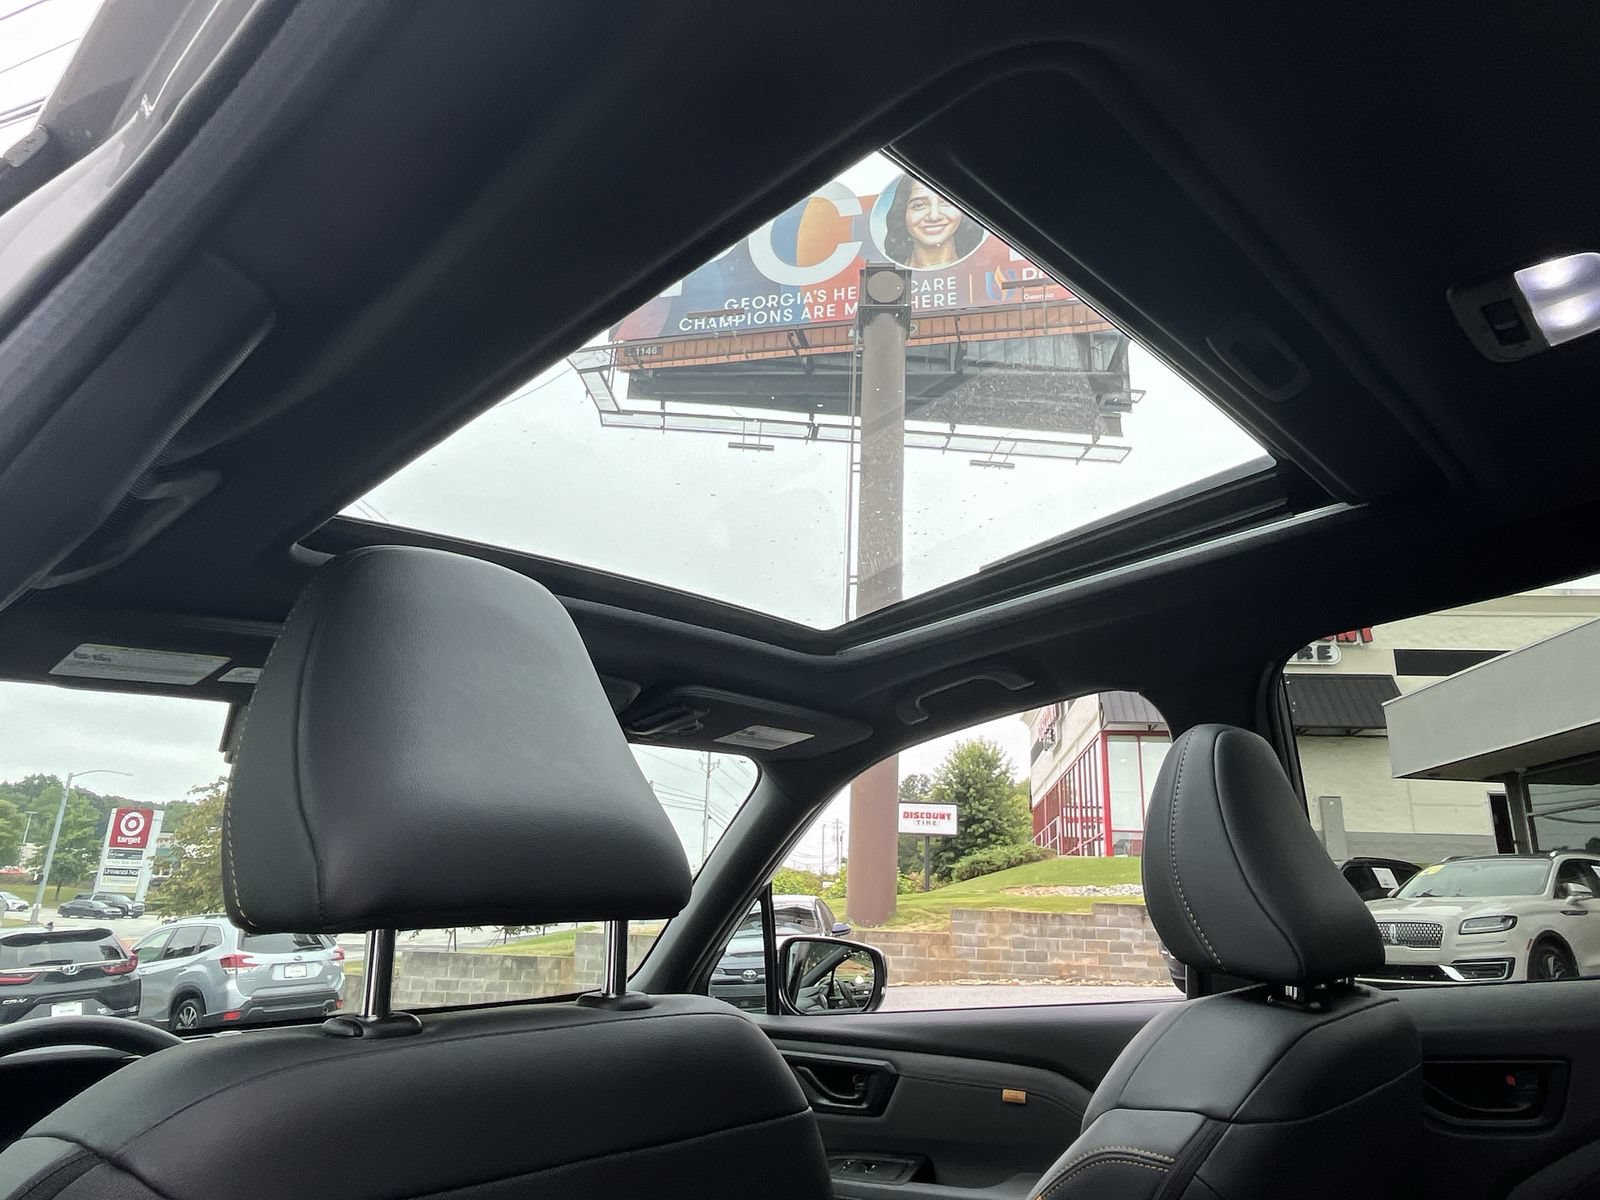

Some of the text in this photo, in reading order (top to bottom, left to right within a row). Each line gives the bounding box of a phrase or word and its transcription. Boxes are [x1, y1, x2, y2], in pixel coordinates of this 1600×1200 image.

[724, 289, 828, 310] GEORGIA'S
[679, 308, 793, 331] CHAMPIONS
[801, 303, 836, 319] ARE
[635, 346, 658, 356] 1146
[902, 811, 952, 820] DISCOUNT
